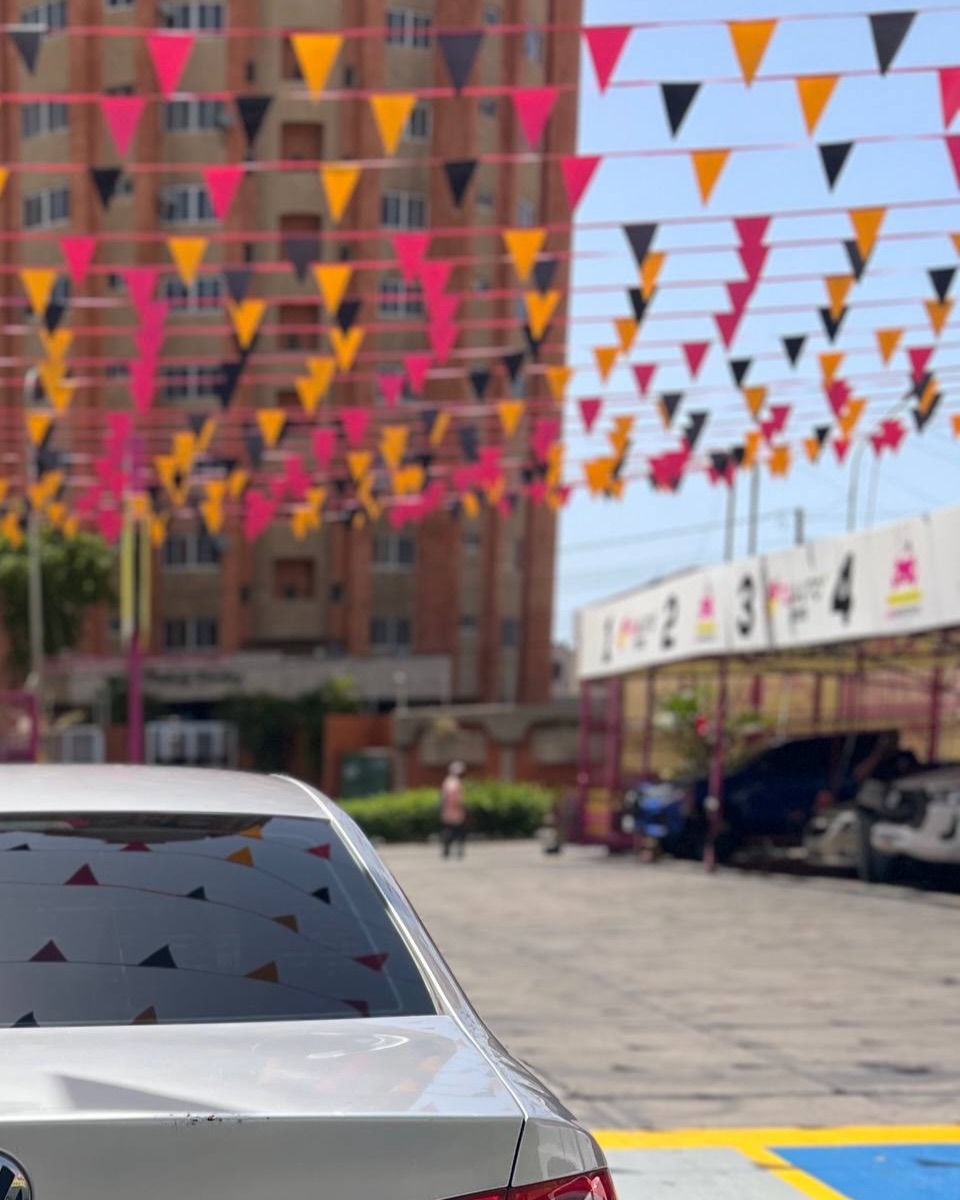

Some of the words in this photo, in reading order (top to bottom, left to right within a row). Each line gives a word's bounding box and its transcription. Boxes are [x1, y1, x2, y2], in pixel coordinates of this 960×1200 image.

[660, 592, 680, 650] 2
[736, 572, 757, 638] 3
[830, 549, 855, 628] 4
